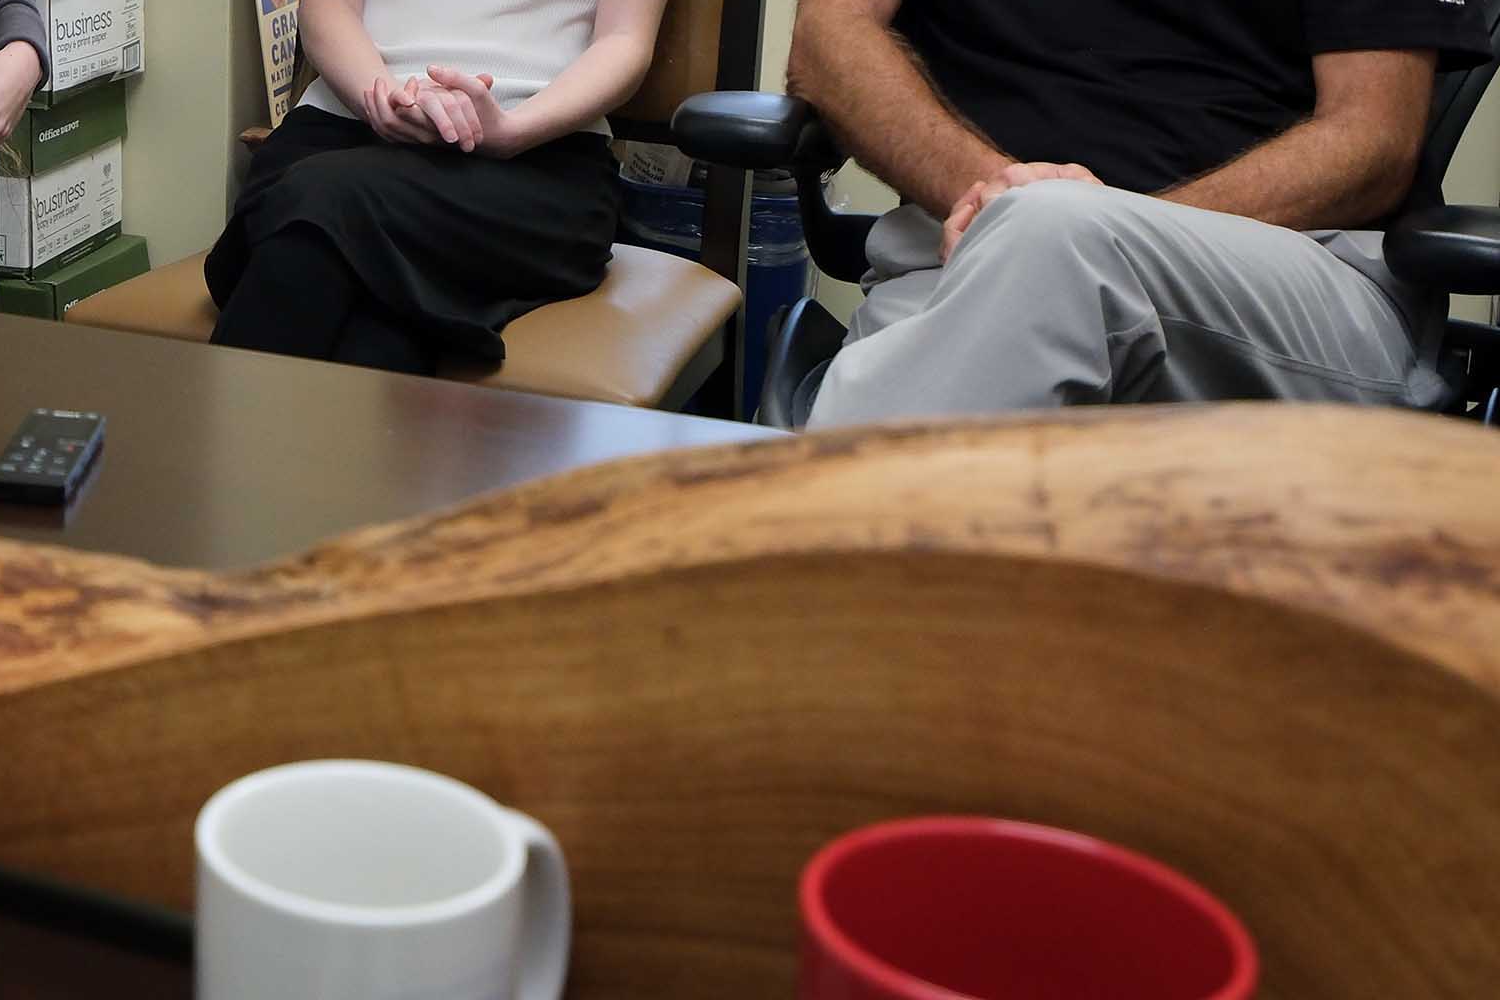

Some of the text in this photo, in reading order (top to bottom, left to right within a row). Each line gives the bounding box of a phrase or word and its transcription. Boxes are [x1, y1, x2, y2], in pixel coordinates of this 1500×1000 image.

[55, 11, 113, 41] business
[57, 42, 72, 53] copy
[77, 36, 91, 49] print
[91, 32, 107, 45] paper
[38, 120, 80, 143] Office DEPOT
[35, 180, 86, 218] business
[53, 210, 66, 224] print
[66, 203, 80, 217] paper
